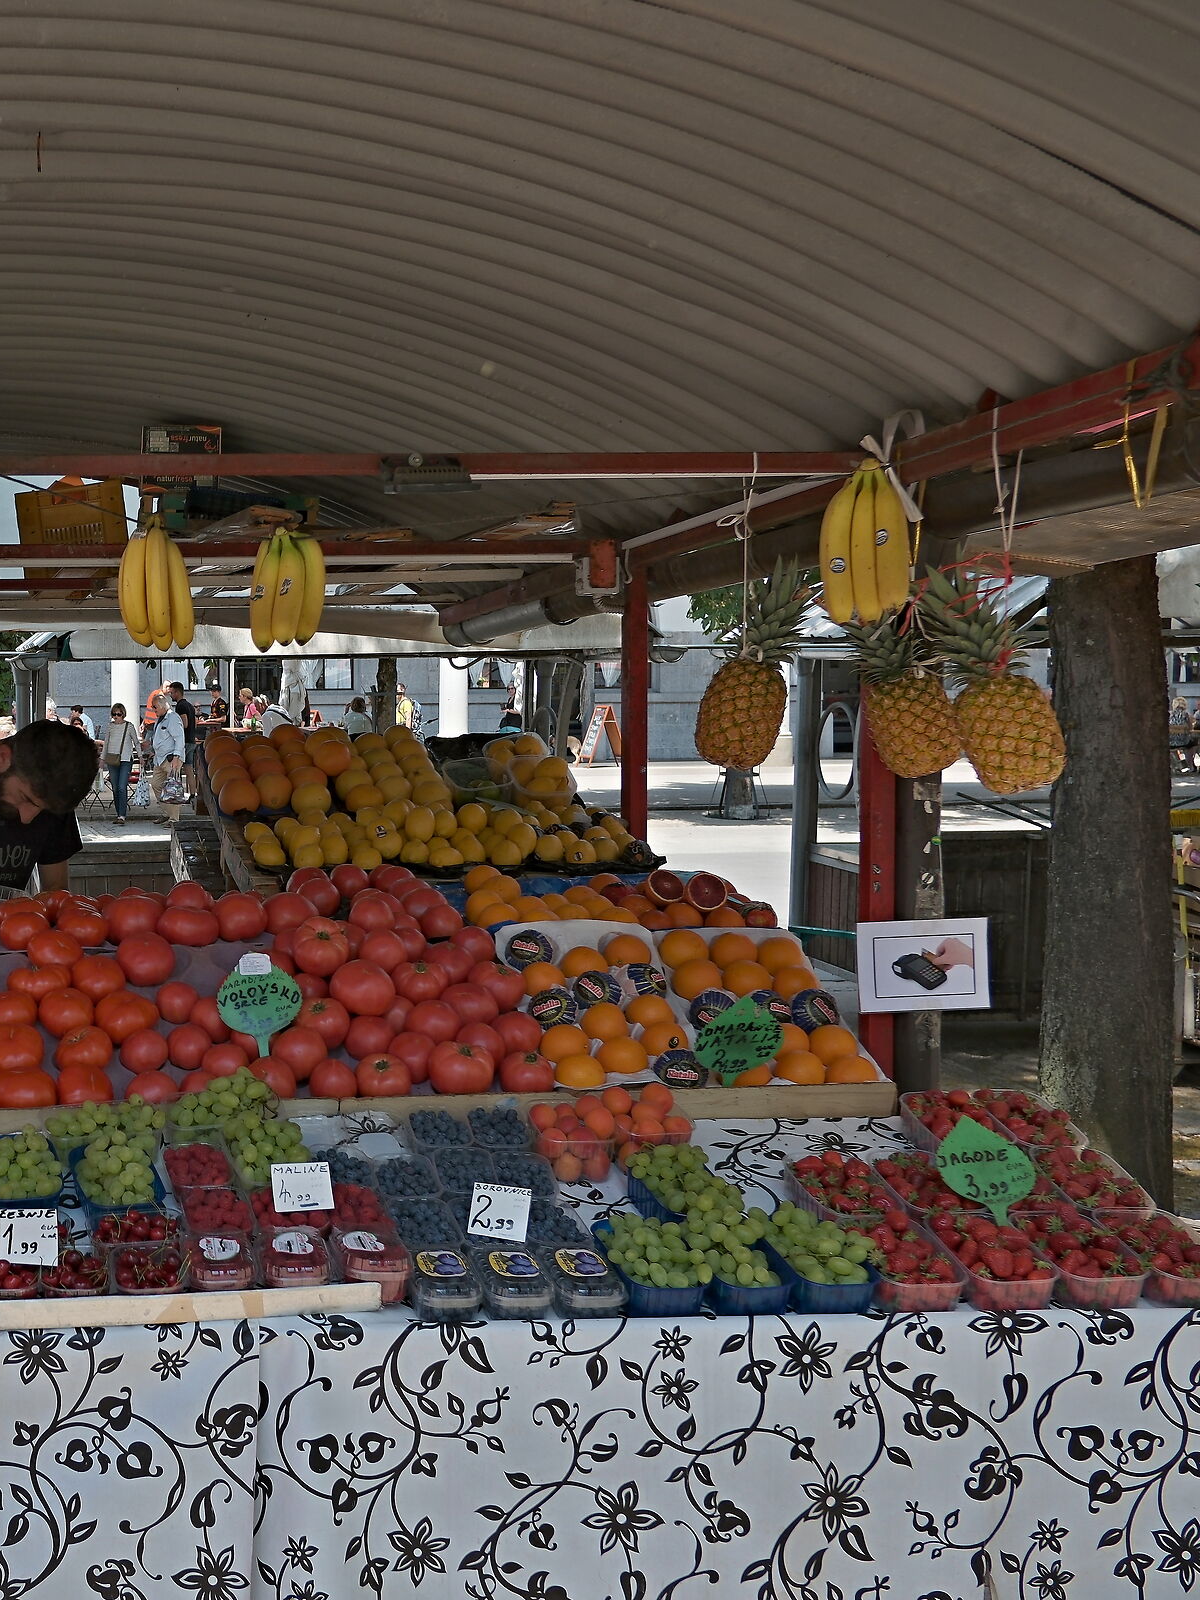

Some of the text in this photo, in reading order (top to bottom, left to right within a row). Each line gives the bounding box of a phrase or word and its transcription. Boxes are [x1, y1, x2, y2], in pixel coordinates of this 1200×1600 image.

[234, 996, 268, 1010] SRCE
[273, 1164, 328, 1174] MALINE
[936, 1148, 1009, 1168] JAGODE
[279, 1179, 312, 1205] 4,99
[475, 1184, 532, 1196] BOROVNICE
[964, 1174, 1009, 1198] 3,99
[470, 1194, 514, 1231] 2,99
[2, 1223, 38, 1255] 1.99
